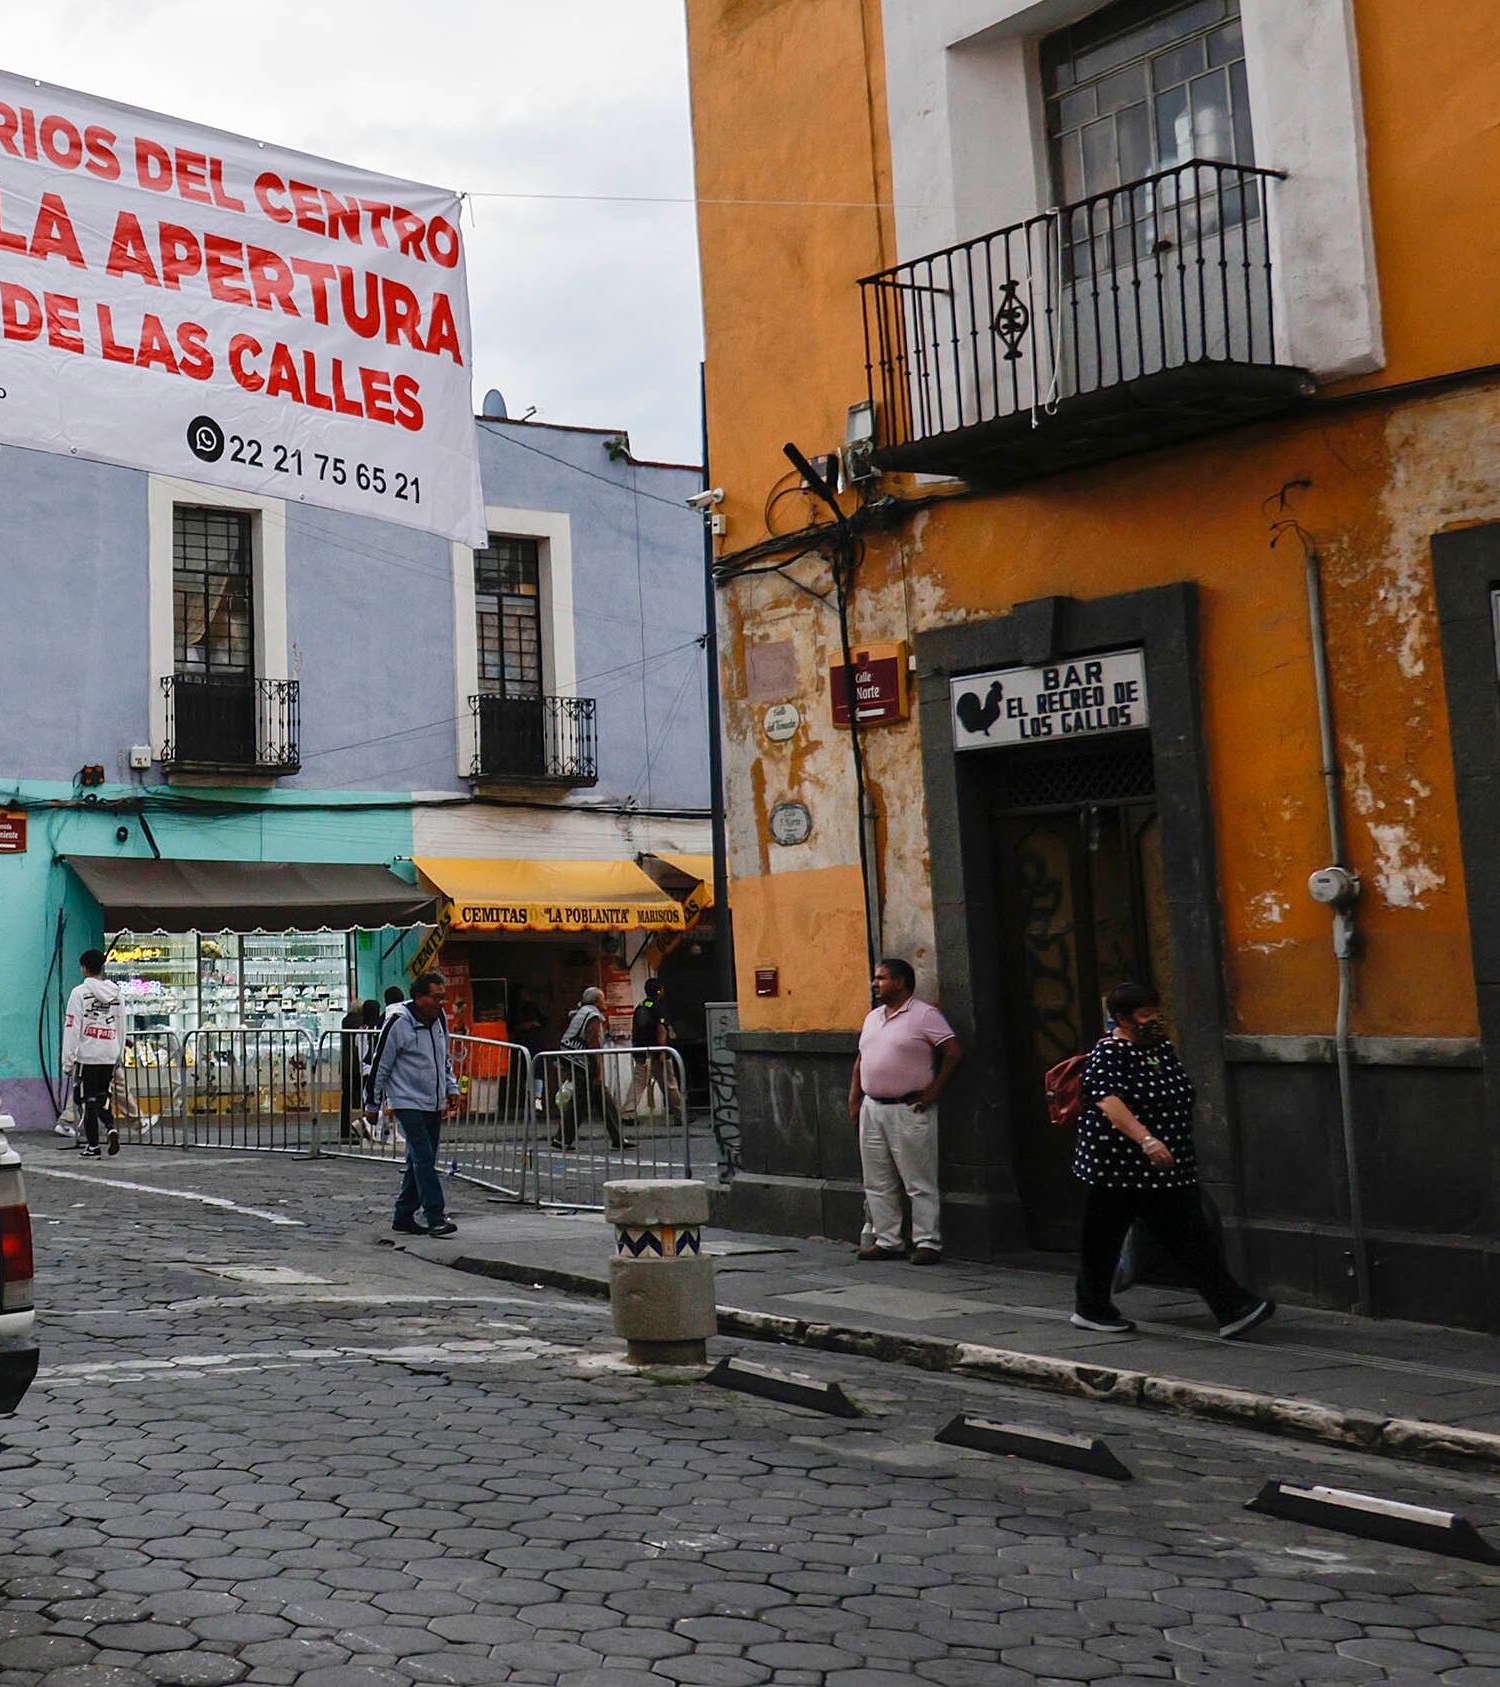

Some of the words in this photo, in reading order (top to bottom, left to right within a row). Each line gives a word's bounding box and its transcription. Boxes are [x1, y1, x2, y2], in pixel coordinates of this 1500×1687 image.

[136, 138, 244, 211] DEL
[255, 172, 459, 268] CENTRO
[107, 211, 462, 365] APERTURA
[0, 281, 84, 354] DE
[98, 304, 214, 380] LAS
[229, 334, 424, 431] CALLES
[229, 435, 263, 468] 22
[272, 445, 302, 476] 21
[314, 453, 347, 485] 75
[356, 463, 387, 494] 65
[395, 472, 420, 504] 21
[855, 672, 872, 684] Calle
[856, 685, 880, 700] Norte
[1043, 661, 1103, 691] BAR
[1006, 697, 1028, 718] EL
[1036, 686, 1105, 714] RECREO
[1114, 681, 1139, 704] DE
[1020, 715, 1052, 739] LOS
[1061, 705, 1131, 733] GALLOS
[462, 907, 527, 923] CEMITAS
[637, 909, 679, 923] MARISCOS
